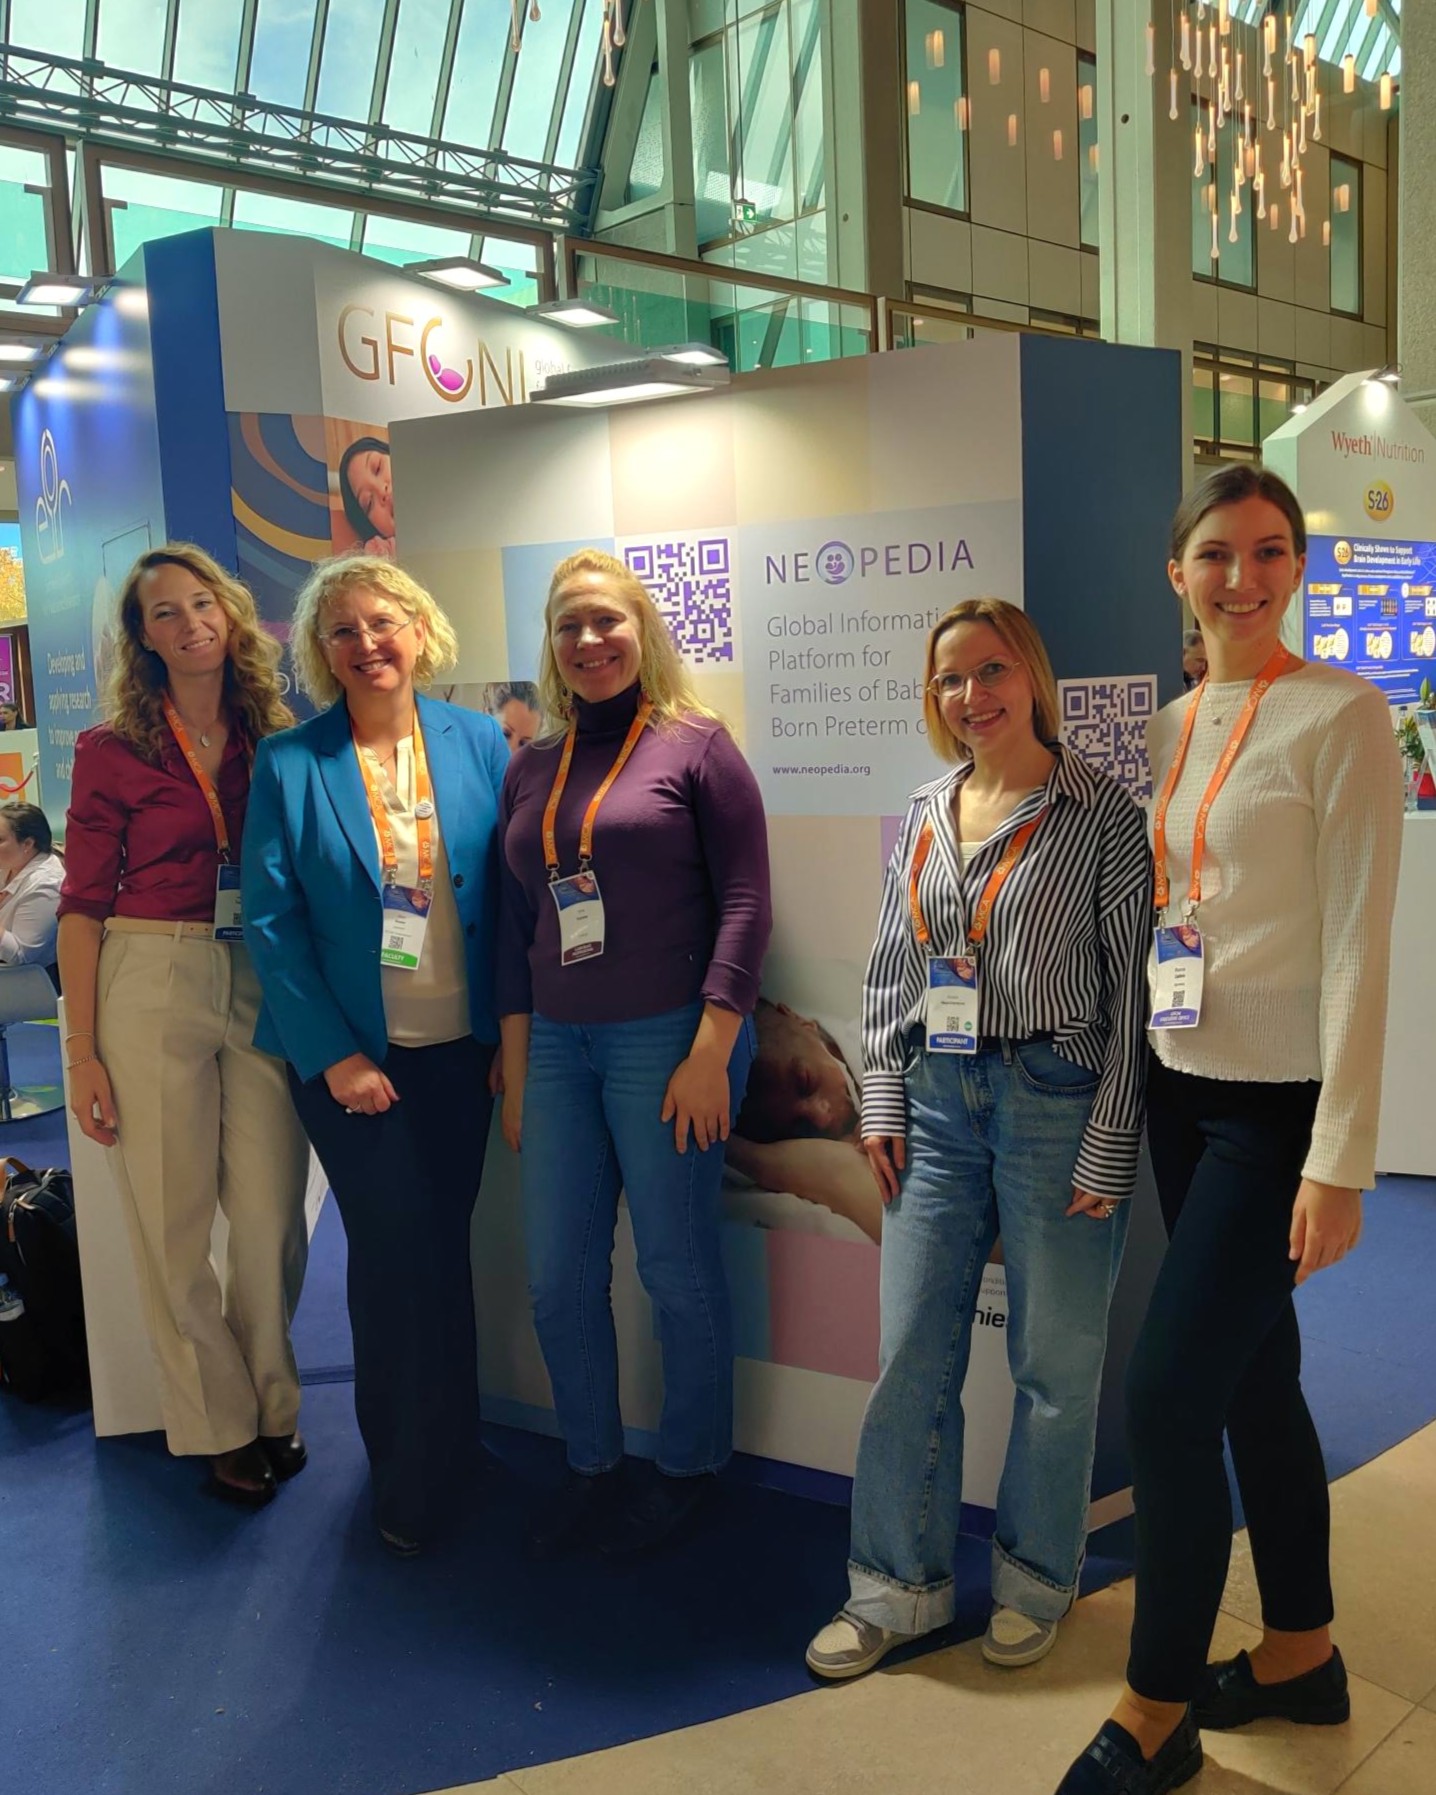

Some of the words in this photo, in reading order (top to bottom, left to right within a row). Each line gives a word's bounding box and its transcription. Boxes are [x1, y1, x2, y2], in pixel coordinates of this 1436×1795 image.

[1377, 435, 1425, 464] Nutrition
[766, 539, 975, 585] NEOPEDIA
[767, 612, 833, 638] Global
[841, 607, 942, 634] Informati
[769, 647, 856, 671] Platform
[862, 644, 891, 667] for
[770, 681, 852, 704] Families
[858, 678, 881, 701] of
[886, 678, 924, 701] Bab
[772, 717, 818, 738] Born
[826, 715, 908, 737] Preterm
[916, 718, 928, 735] o
[773, 764, 871, 776] www.neopedia.org
[936, 1036, 968, 1045] PARTICIPANT
